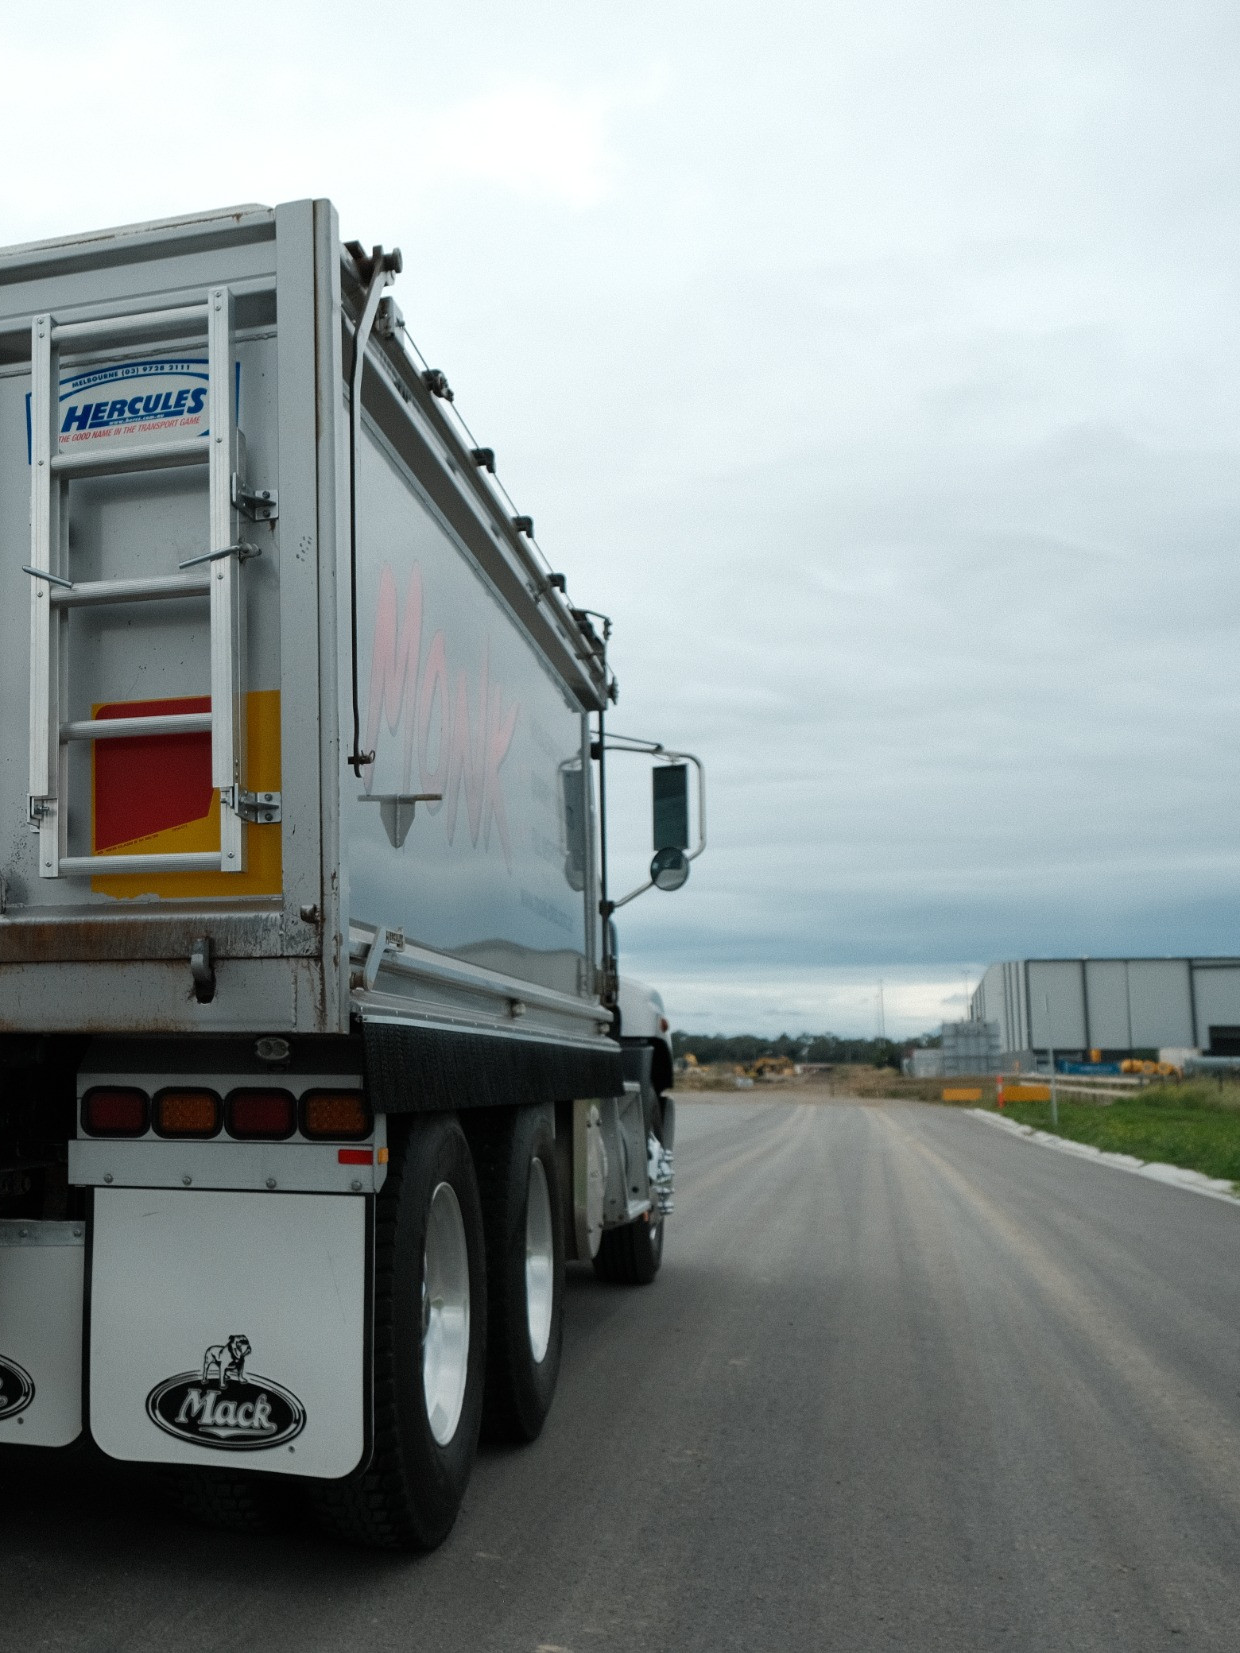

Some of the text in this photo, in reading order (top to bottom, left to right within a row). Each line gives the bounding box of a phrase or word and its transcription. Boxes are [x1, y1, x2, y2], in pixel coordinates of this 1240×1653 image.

[72, 371, 119, 388] MELBOURNE
[121, 367, 139, 377] (03)
[143, 364, 165, 373] 9728
[61, 387, 208, 433] HERCULES
[59, 416, 201, 443] THE GOOD NAME IN THE TRANSPORT GAME
[175, 1388, 278, 1430] Mack
